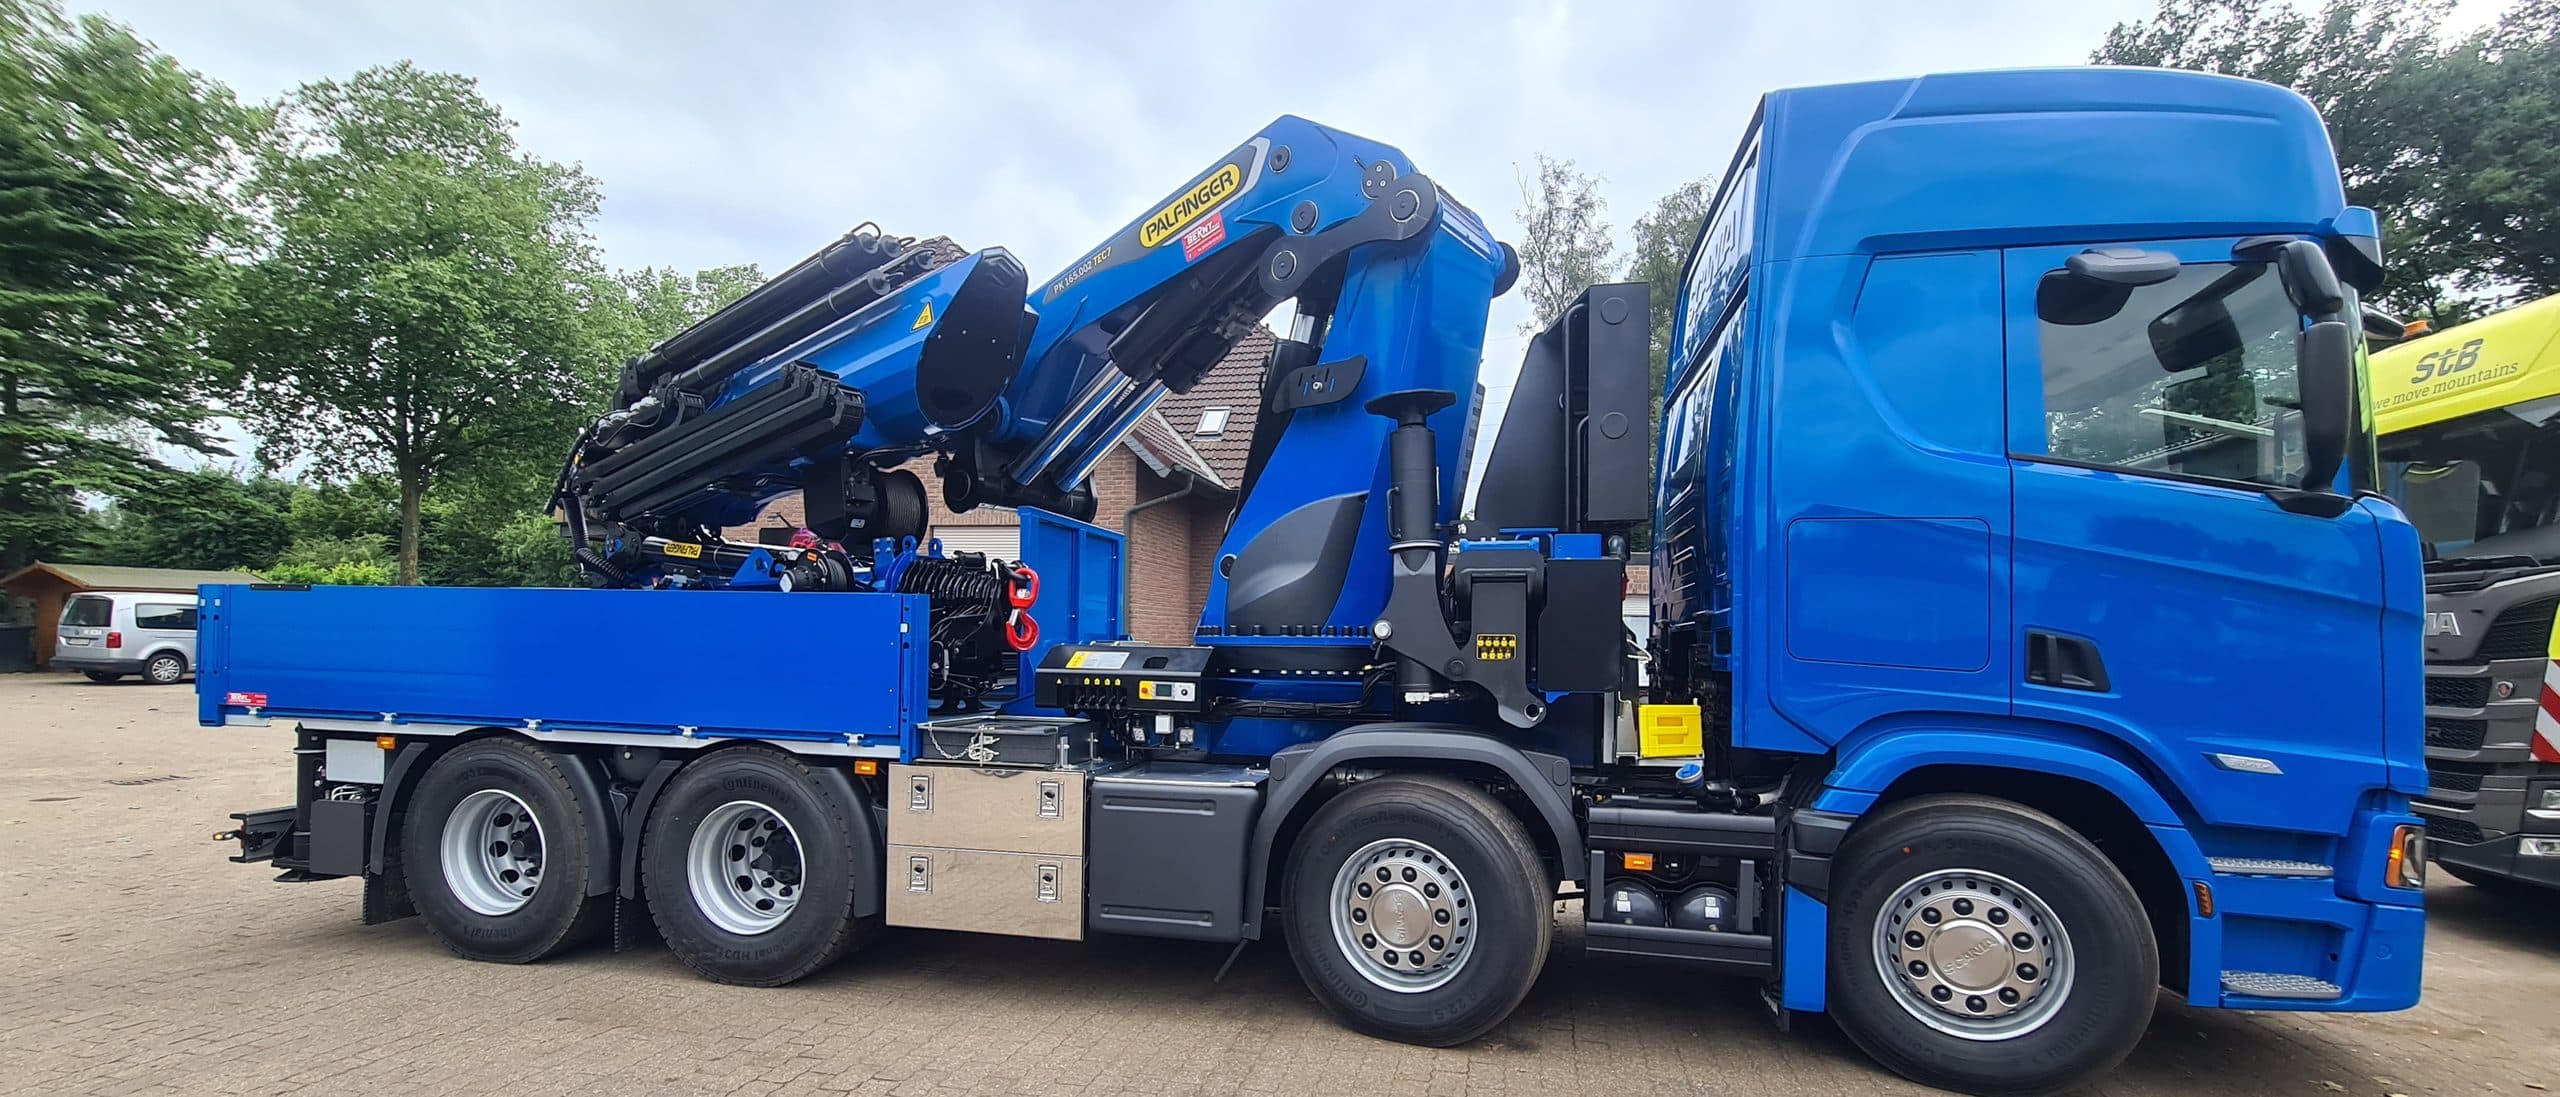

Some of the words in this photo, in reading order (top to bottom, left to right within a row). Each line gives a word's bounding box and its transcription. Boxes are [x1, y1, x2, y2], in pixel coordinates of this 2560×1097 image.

[1146, 170, 1234, 242] PALFINGER
[1053, 284, 1065, 294] PK
[1065, 261, 1092, 286] 165.002
[1093, 246, 1112, 266] TEC7
[2411, 338, 2484, 384] StB
[2373, 397, 2391, 410] we
[2392, 386, 2430, 406] move
[2432, 362, 2519, 395] mountains
[1944, 937, 1998, 975] SCANIA
